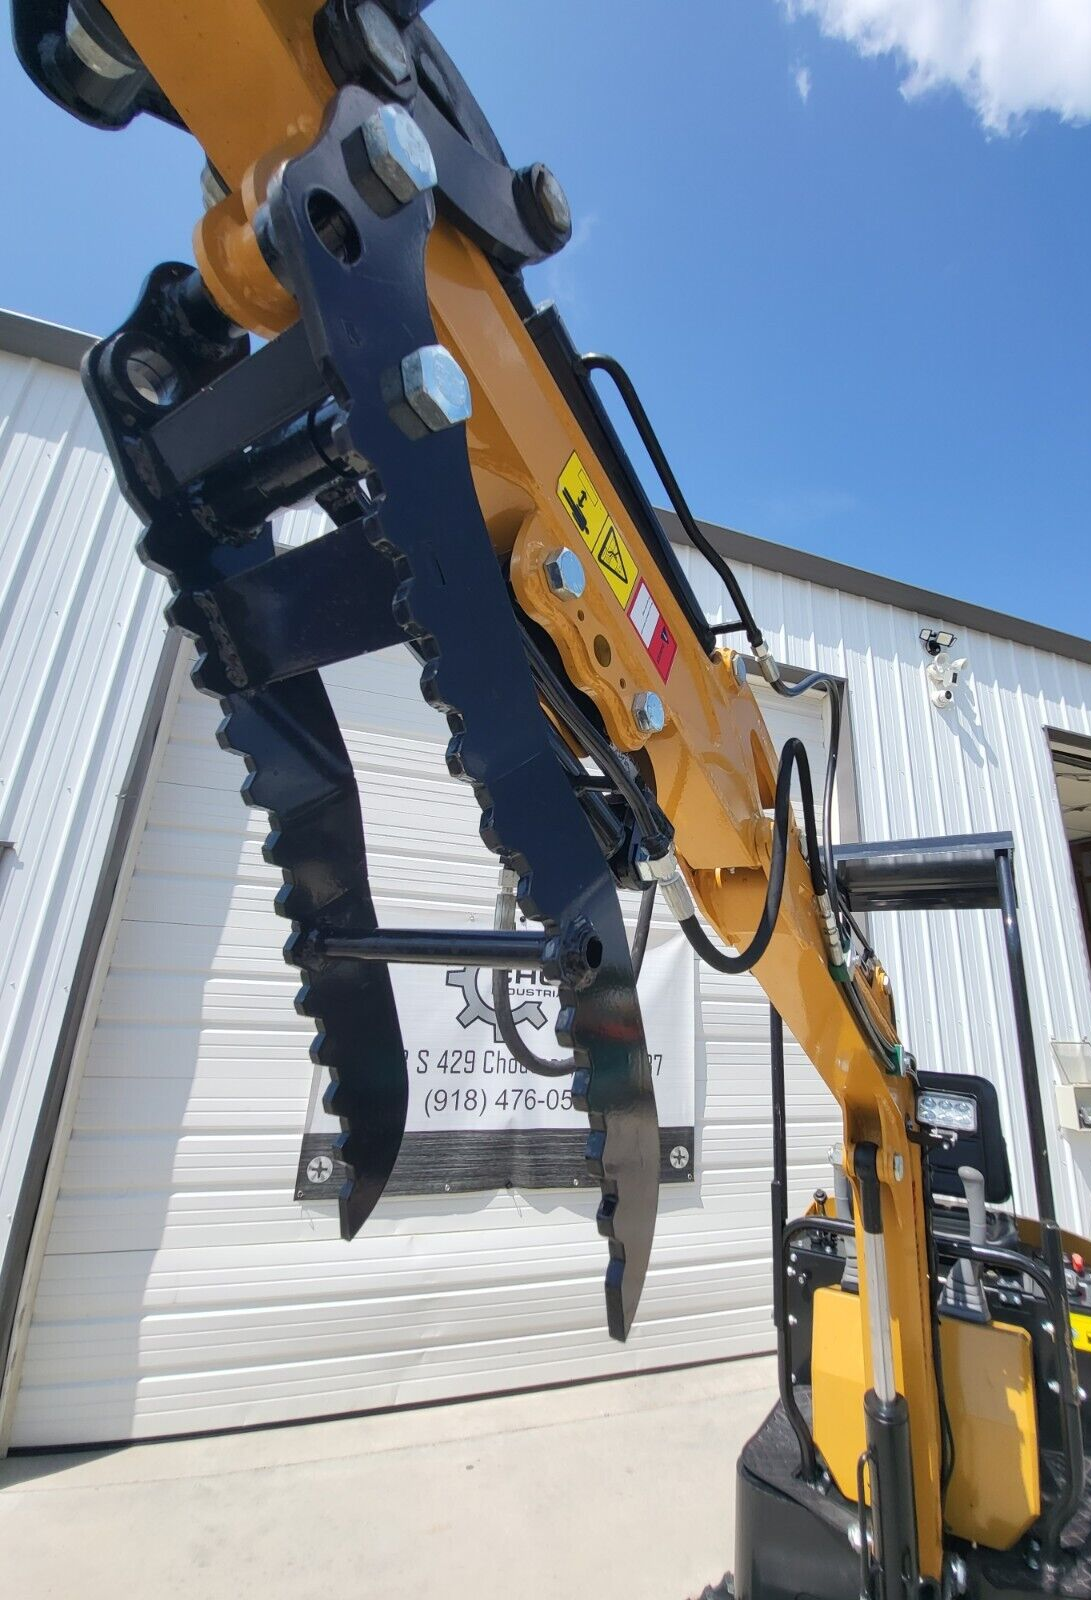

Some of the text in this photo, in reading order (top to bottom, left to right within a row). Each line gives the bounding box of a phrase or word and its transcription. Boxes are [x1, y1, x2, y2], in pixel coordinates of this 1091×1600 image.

[508, 987, 560, 998] DUSTRI
[417, 1049, 430, 1074] S
[437, 1050, 476, 1074] 429
[424, 1088, 573, 1118] (918) 476-05
